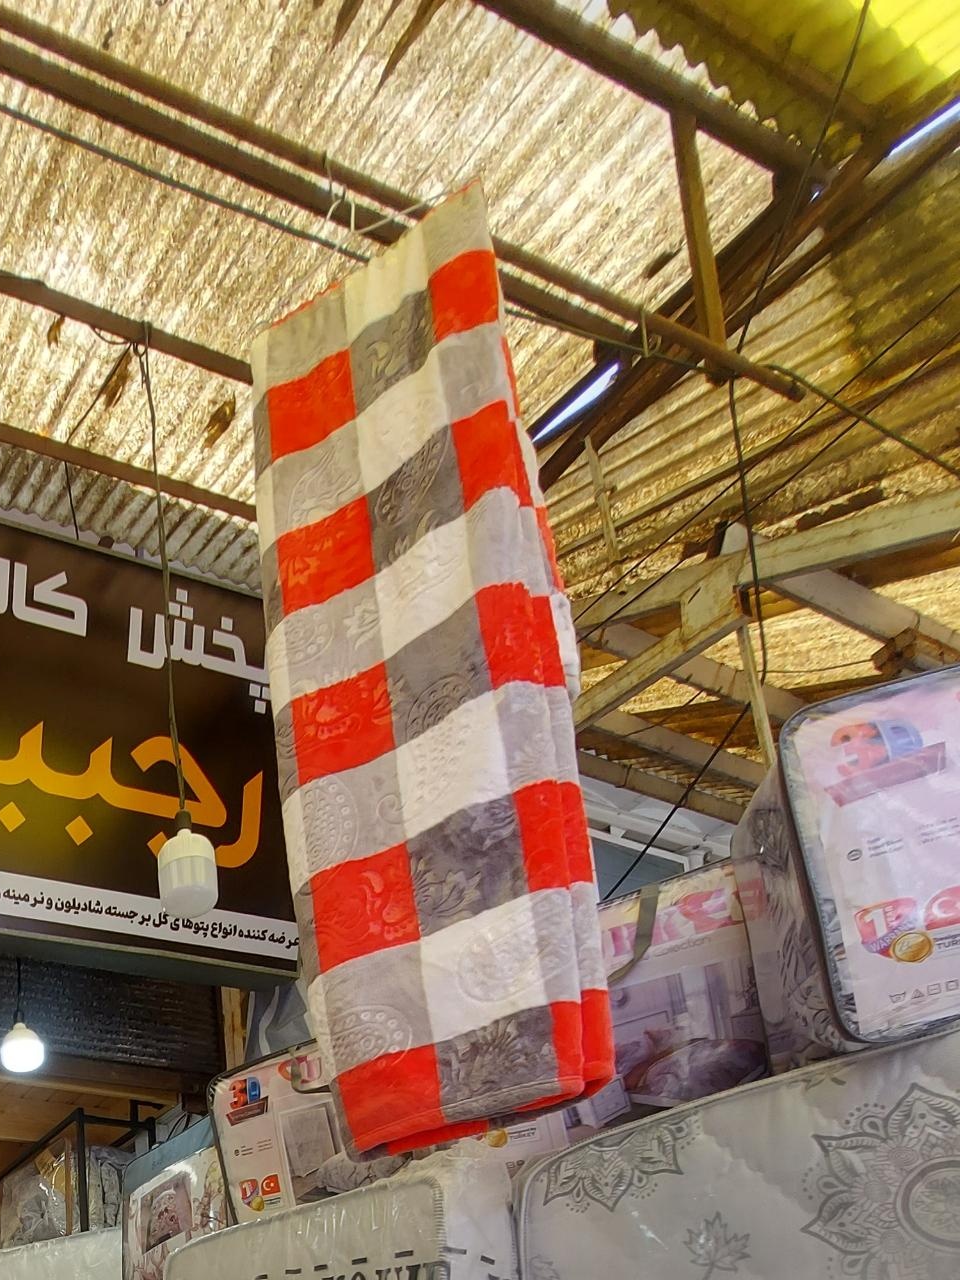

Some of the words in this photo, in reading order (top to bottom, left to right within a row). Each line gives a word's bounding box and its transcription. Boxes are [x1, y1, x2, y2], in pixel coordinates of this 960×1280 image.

[127, 587, 271, 715] پخش
[170, 917, 209, 938] پتوهای
[210, 921, 237, 939] انواع
[238, 928, 268, 942] کننده
[268, 931, 300, 949] عرضه
